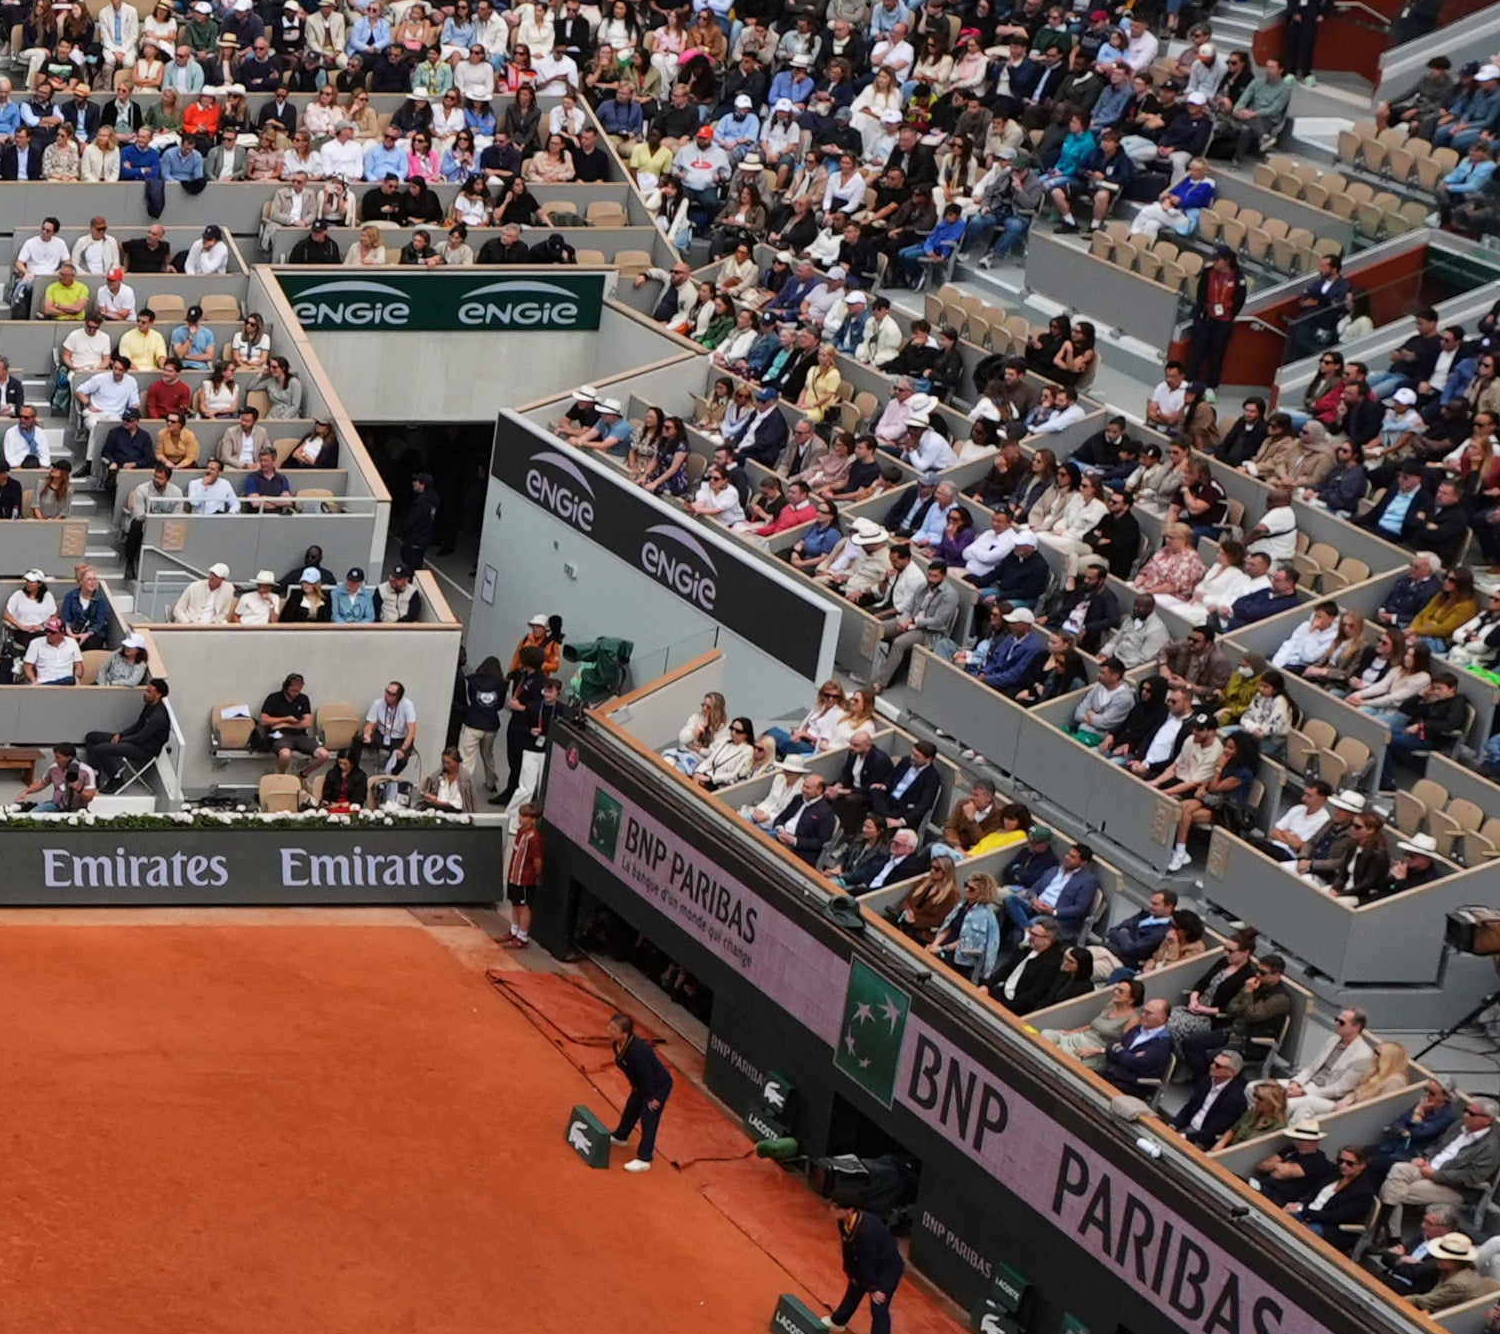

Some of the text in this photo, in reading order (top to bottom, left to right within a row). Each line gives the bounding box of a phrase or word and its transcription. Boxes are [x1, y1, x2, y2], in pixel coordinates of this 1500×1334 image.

[42, 847, 227, 888] Emirates
[280, 847, 465, 888] Emirates
[625, 816, 757, 945] BNP PARIBAS
[731, 1050, 766, 1087] PARIBA
[908, 1032, 1008, 1153] BNP
[922, 1211, 992, 1279] BNP PARIBAS
